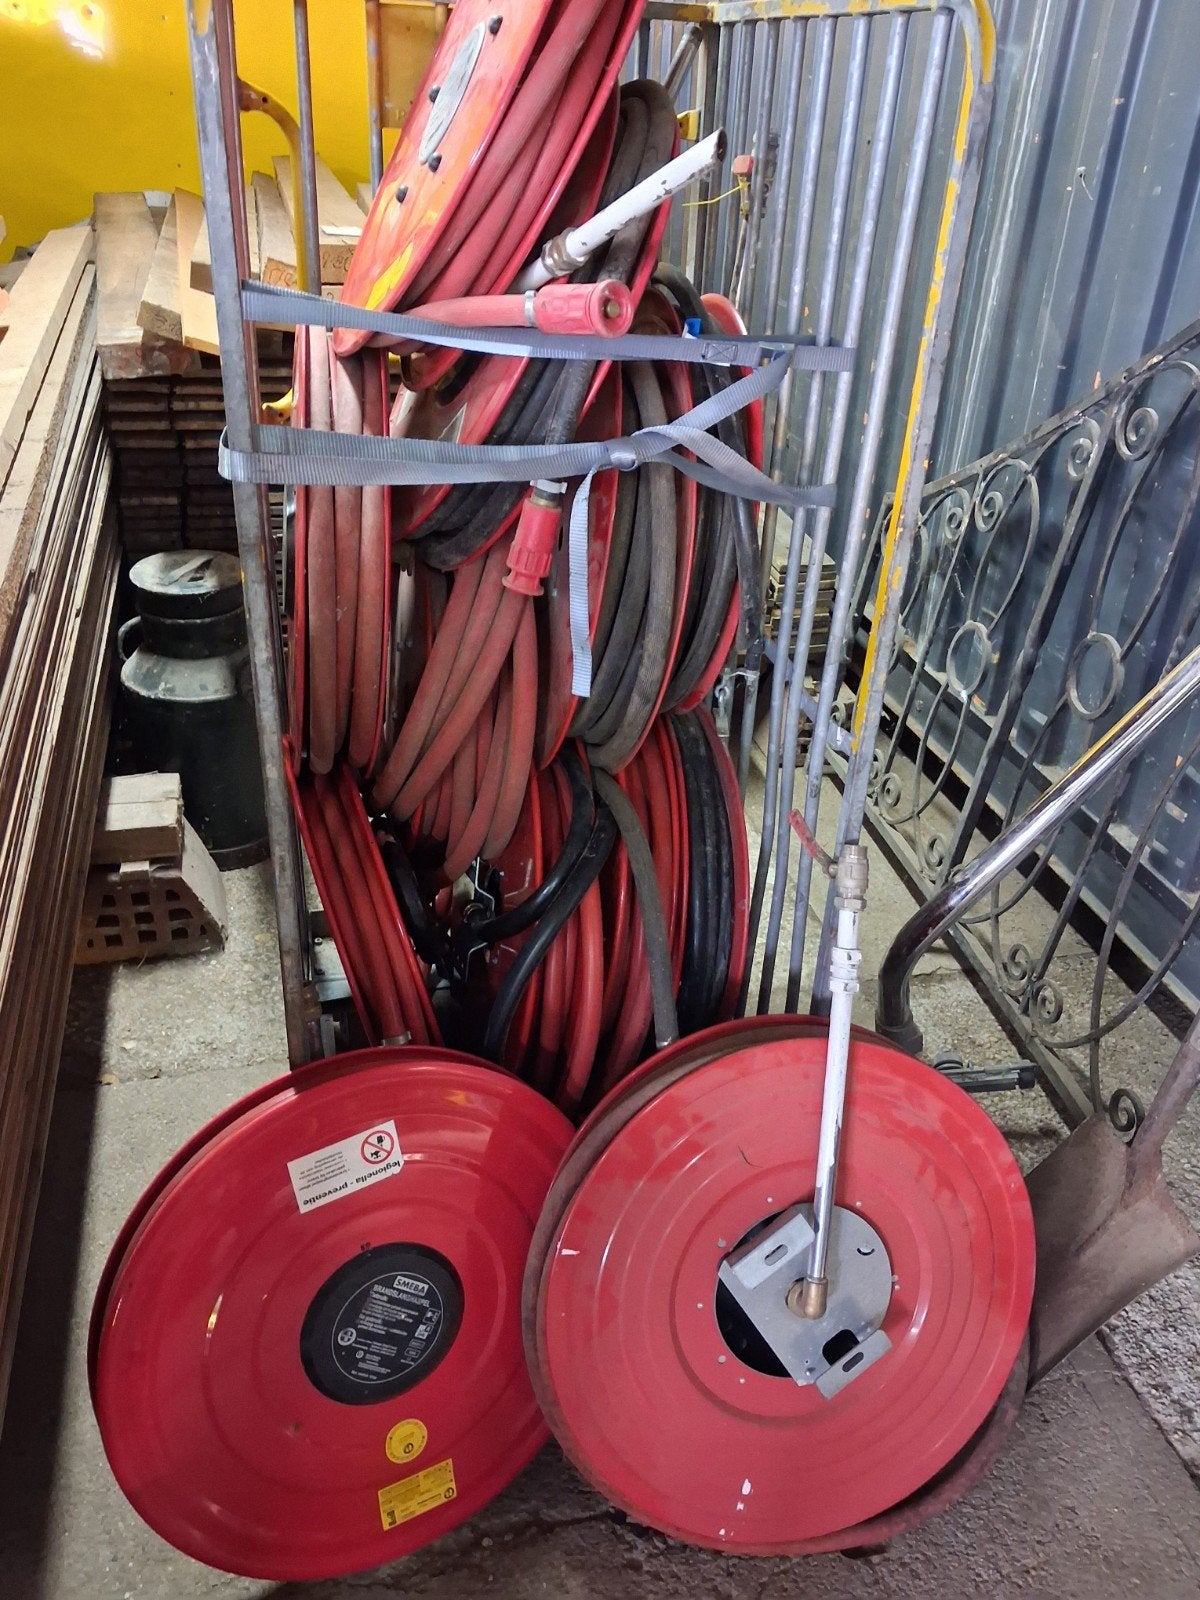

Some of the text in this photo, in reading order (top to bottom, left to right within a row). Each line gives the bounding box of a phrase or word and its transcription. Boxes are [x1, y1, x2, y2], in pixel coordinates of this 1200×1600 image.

[355, 1160, 401, 1184] legionella
[303, 1181, 348, 1206] preventie
[397, 1278, 426, 1294] SMEBA
